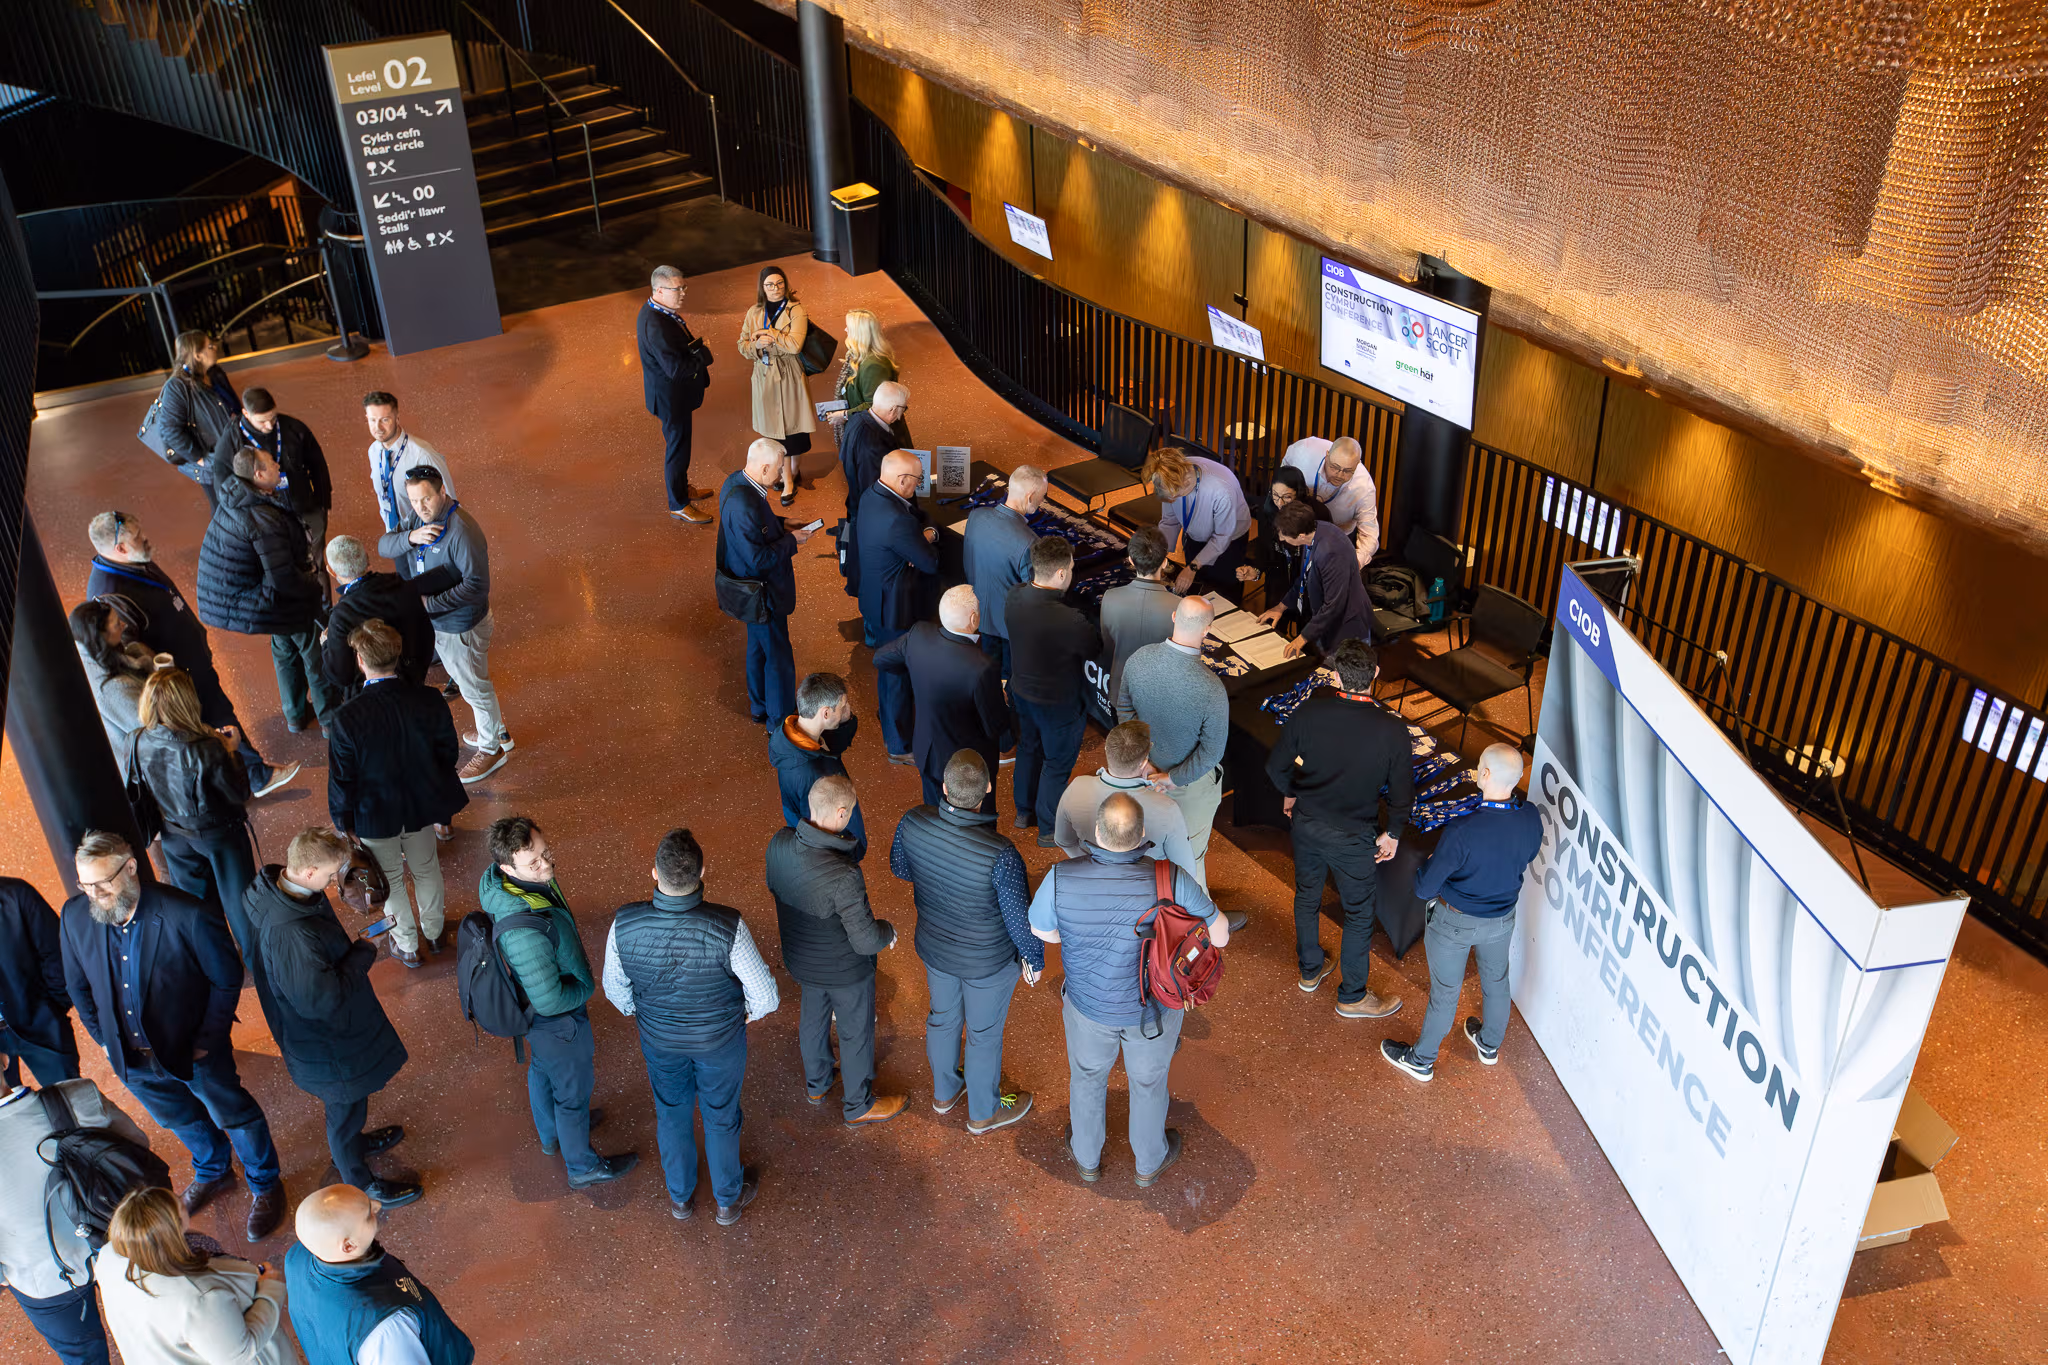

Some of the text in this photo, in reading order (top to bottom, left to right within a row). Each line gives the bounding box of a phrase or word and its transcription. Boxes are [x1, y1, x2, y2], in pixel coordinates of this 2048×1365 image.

[348, 70, 377, 84] Lefel
[383, 56, 432, 90] 02
[350, 82, 381, 96] Level
[356, 104, 408, 126] 03/04
[361, 127, 421, 146] Cylch cefn
[363, 138, 425, 157] Rear circle
[413, 184, 435, 201] 00
[377, 204, 446, 225] Seddi'r llawr
[379, 222, 410, 236] Stalls
[1325, 263, 1345, 278] CIOB
[1325, 282, 1393, 316] CONSTRUCTION
[1325, 291, 1356, 310] CYMRU
[1325, 301, 1383, 331] CONFERENCE
[1427, 323, 1468, 349] LANCER
[1426, 337, 1462, 360] SCOTT
[1395, 360, 1419, 375] green
[1569, 598, 1601, 647] CIOB
[1541, 762, 1800, 1132] CONSTRUCTION
